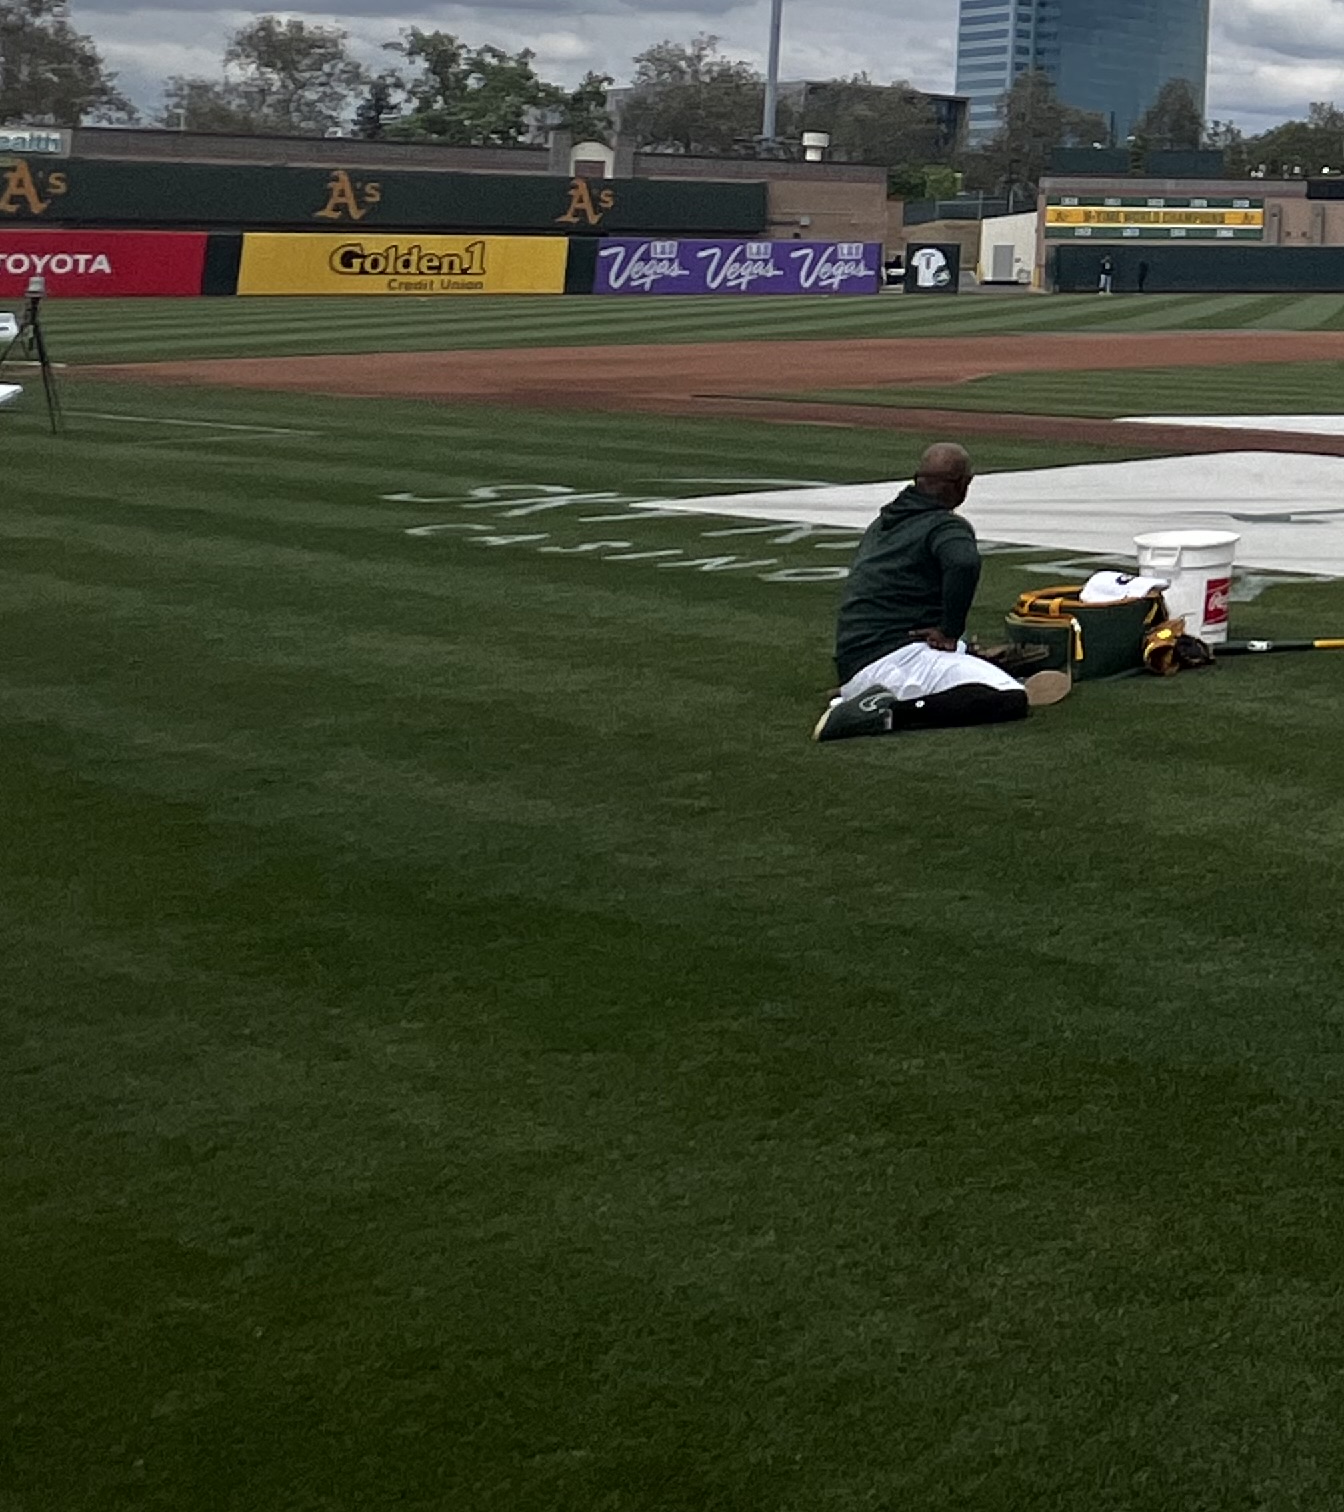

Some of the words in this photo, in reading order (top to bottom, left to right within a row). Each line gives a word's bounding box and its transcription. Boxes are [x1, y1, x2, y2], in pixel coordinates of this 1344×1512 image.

[0, 132, 64, 150] ealth
[313, 170, 381, 220] A's
[555, 178, 614, 225] A's
[599, 243, 690, 291] Vegas
[697, 244, 784, 291] Vegas
[790, 246, 875, 291] Vegas
[404, 523, 850, 581] CASINO
